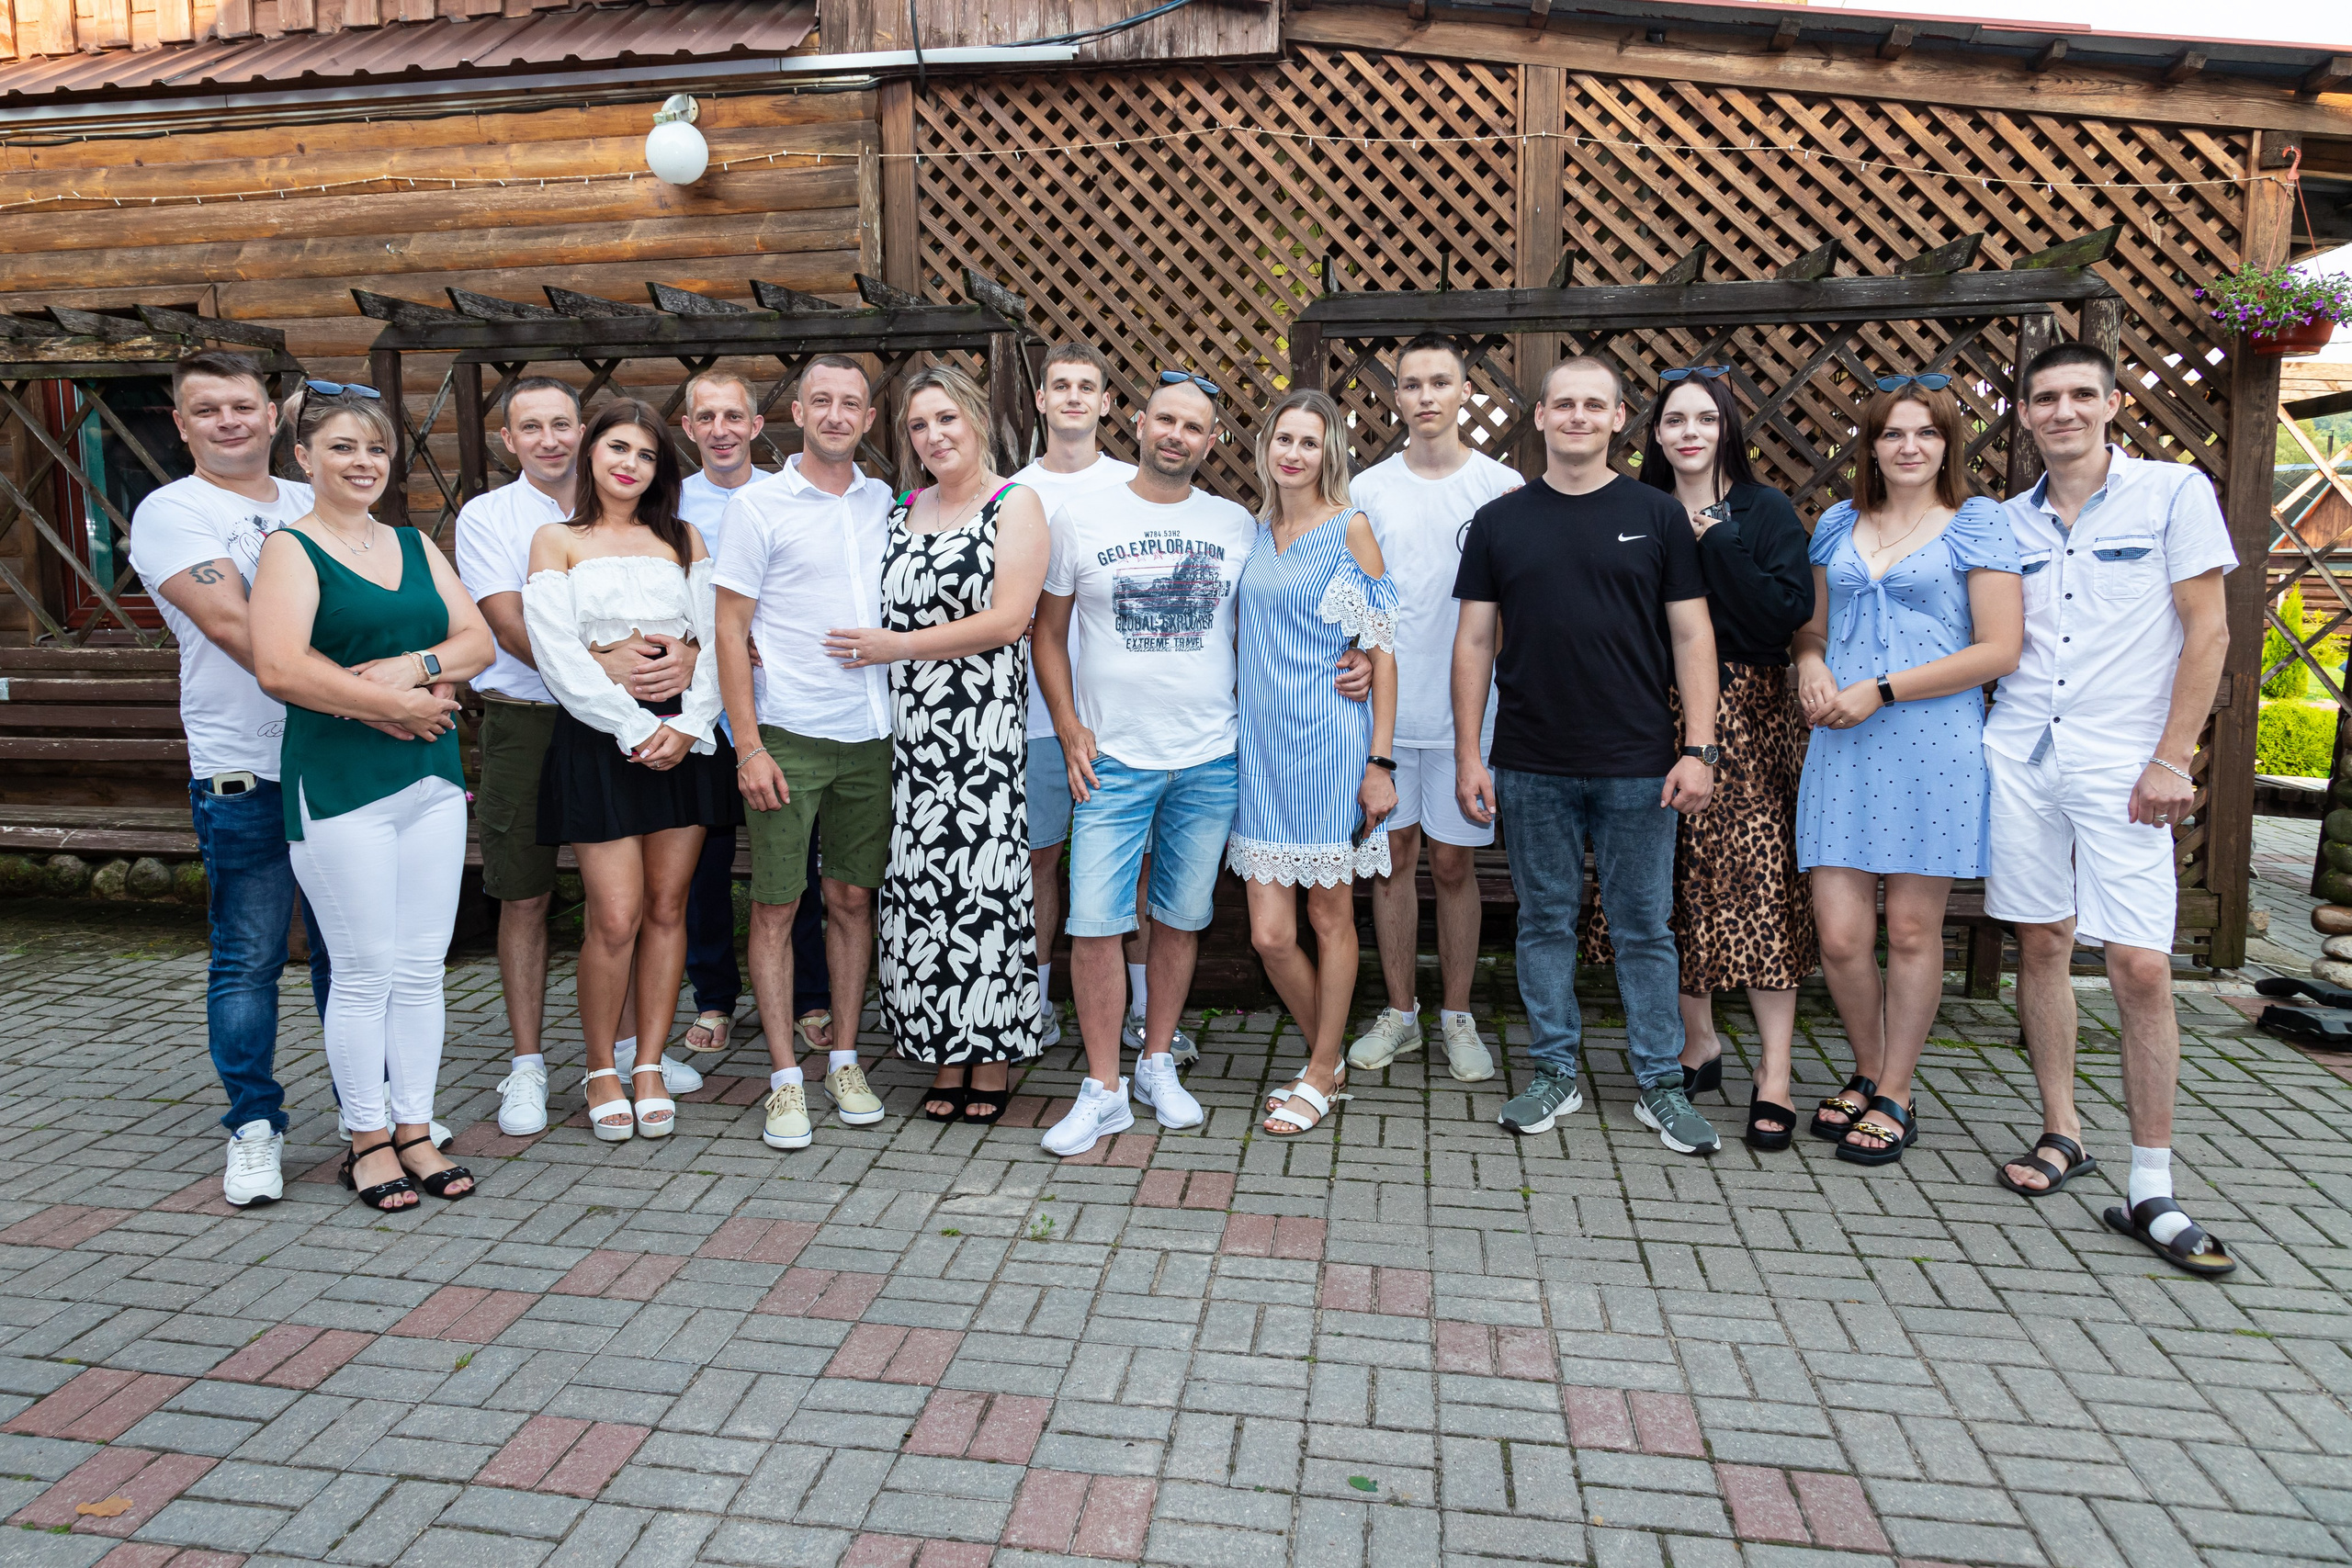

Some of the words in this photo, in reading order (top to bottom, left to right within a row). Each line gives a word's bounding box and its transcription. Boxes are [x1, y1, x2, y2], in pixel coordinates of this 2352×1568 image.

[1097, 538, 1226, 567] GEO.EXPLORATION
[1114, 615, 1156, 631] GLOBAL
[1161, 614, 1215, 631] EXPLORER
[1126, 637, 1170, 649] EXTREME
[1173, 637, 1204, 649] TRAVEL
